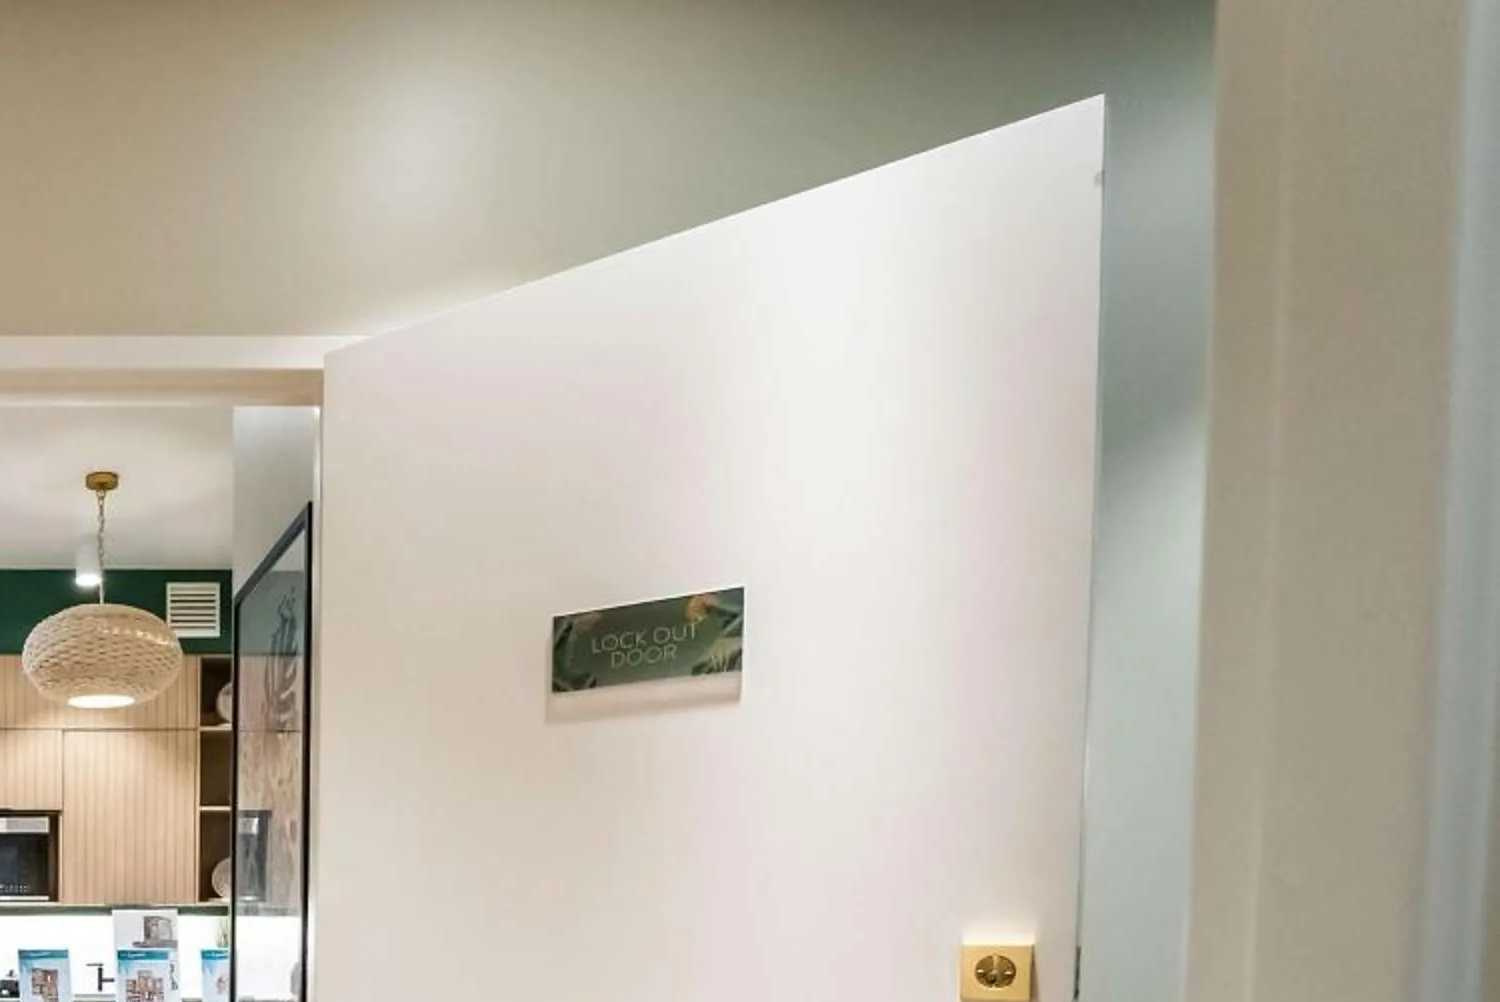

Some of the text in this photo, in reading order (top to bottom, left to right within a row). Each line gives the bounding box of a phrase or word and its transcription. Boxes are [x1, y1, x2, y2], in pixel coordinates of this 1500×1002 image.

[591, 622, 697, 654] LOCK OUT
[611, 643, 677, 668] DOOR
